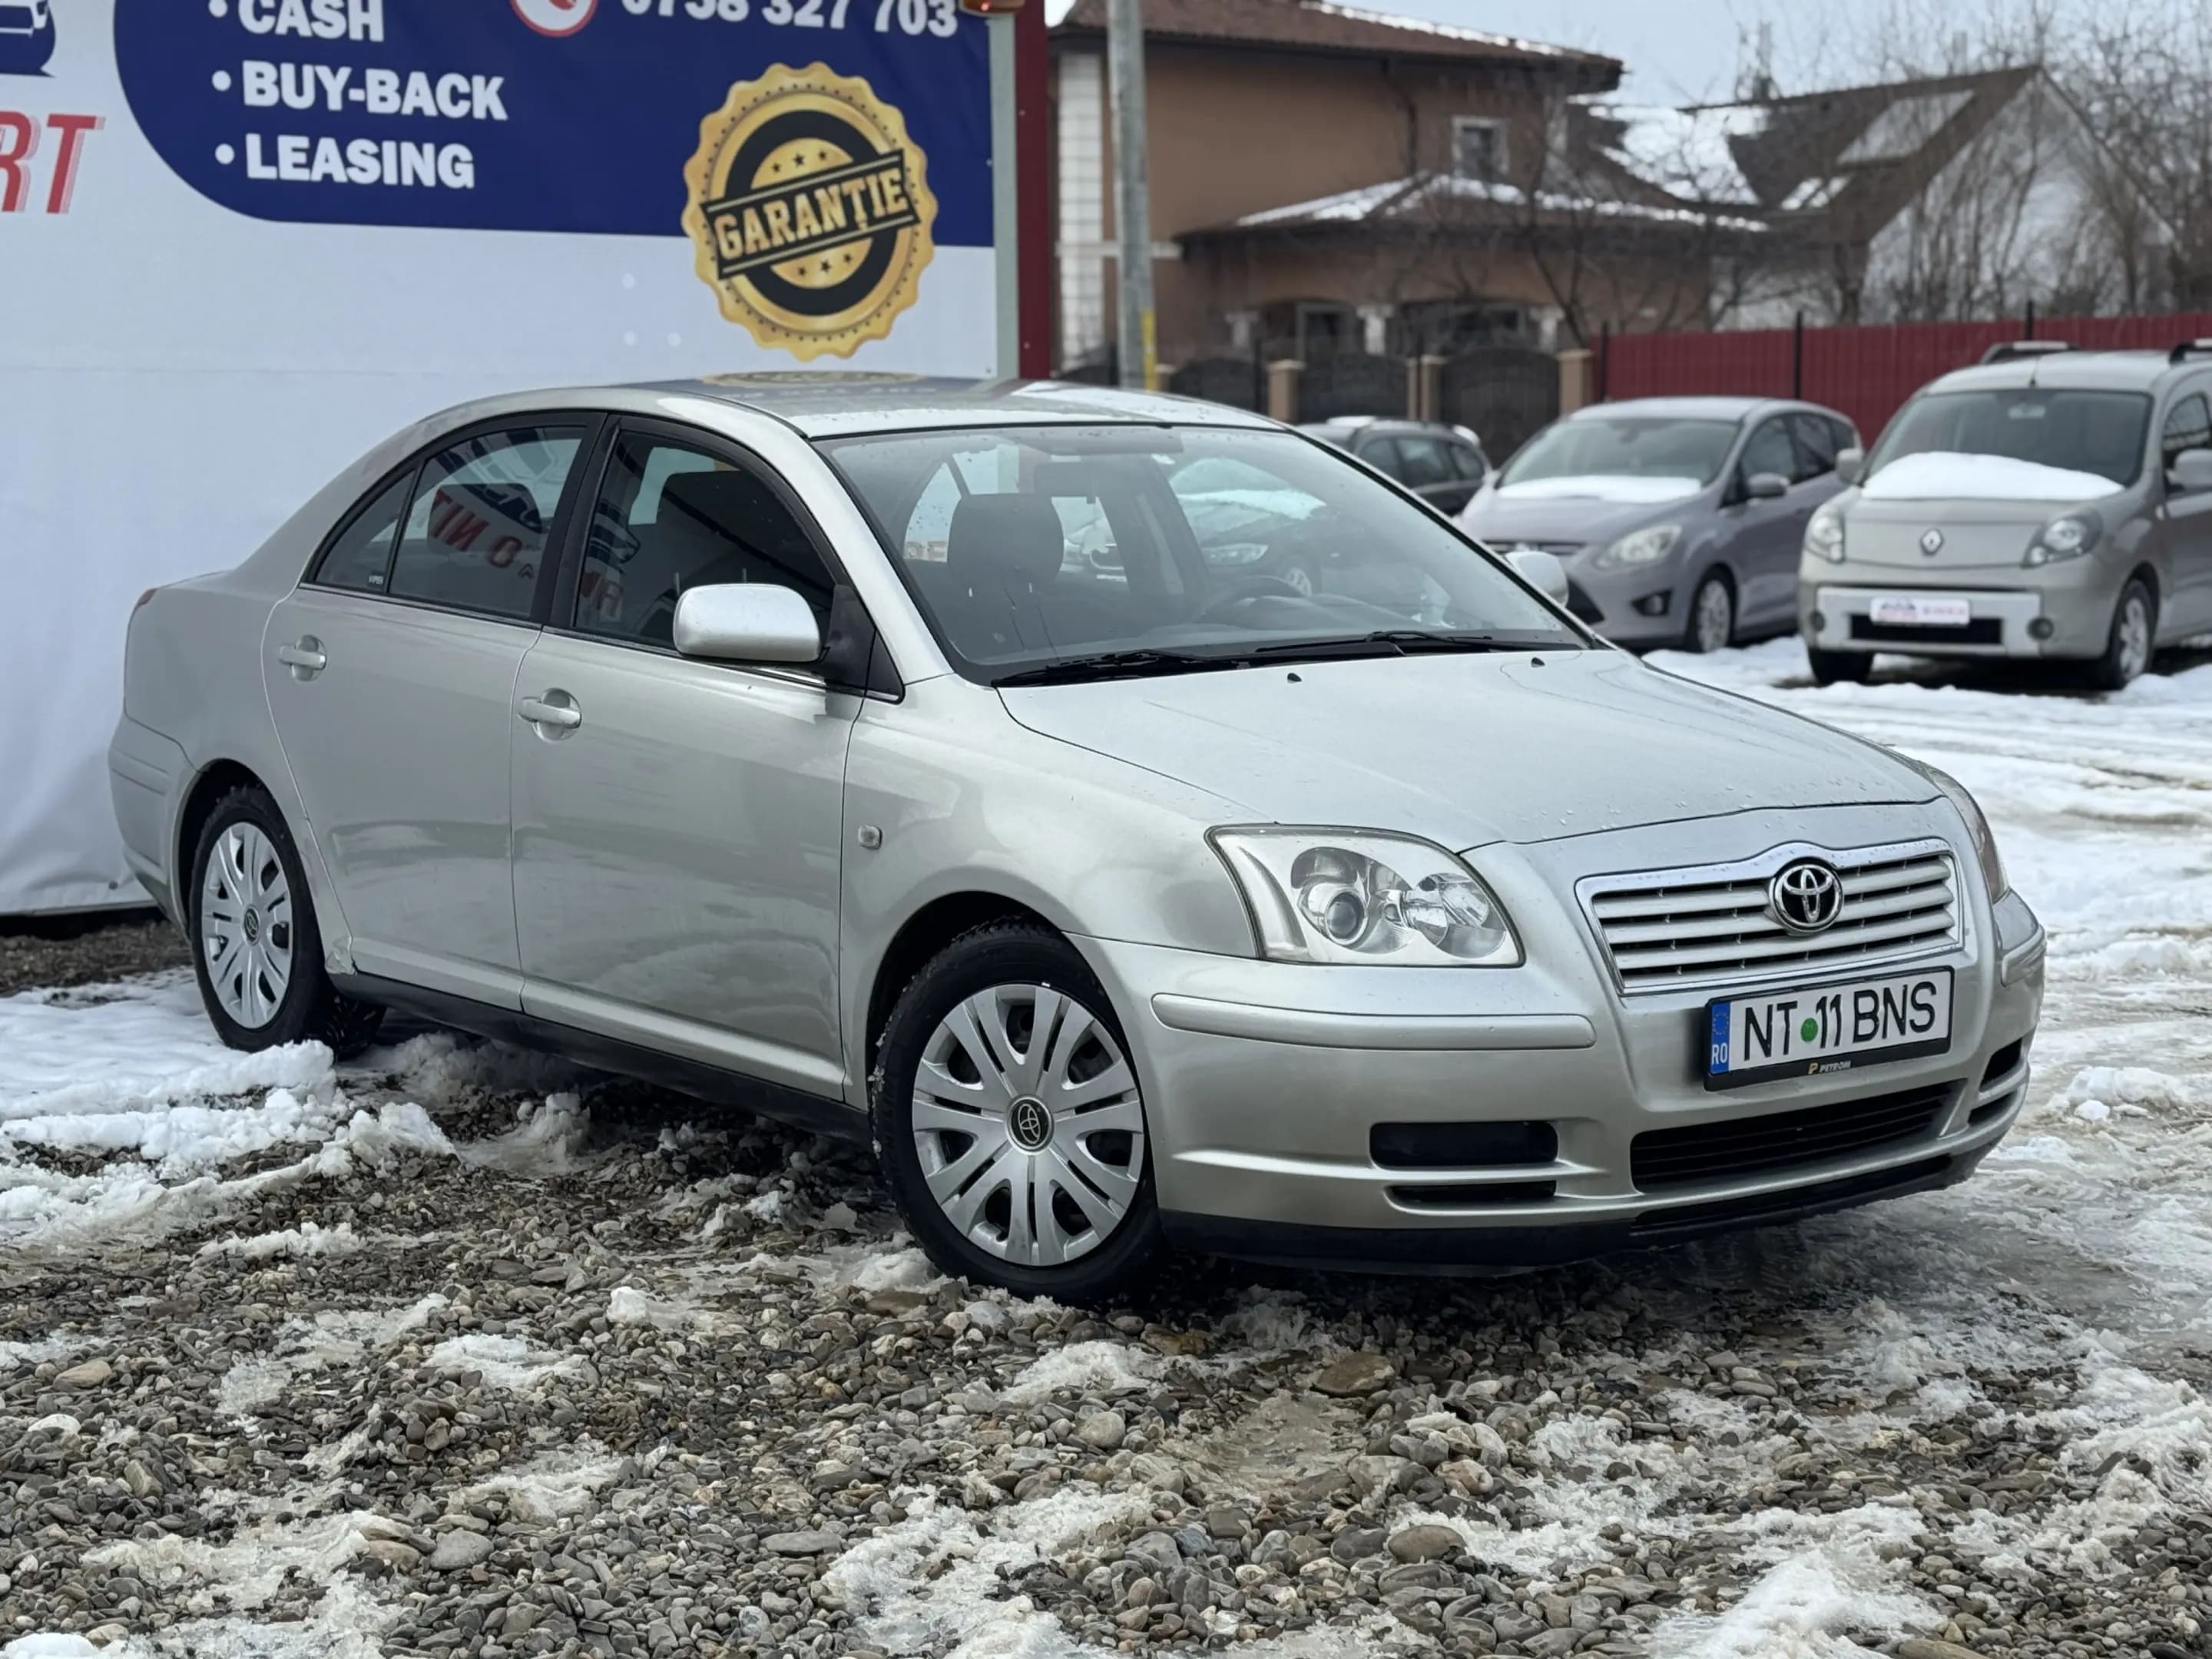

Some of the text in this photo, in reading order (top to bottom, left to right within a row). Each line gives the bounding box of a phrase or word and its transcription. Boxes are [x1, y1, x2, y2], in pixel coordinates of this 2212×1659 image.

[238, 0, 384, 41] CASH
[874, 0, 959, 38] 703
[242, 59, 508, 121] BUY-BACK
[245, 133, 475, 189] LEASING
[1743, 980, 1937, 1061] NT 11 BNS
[1711, 1042, 1728, 1065] RO
